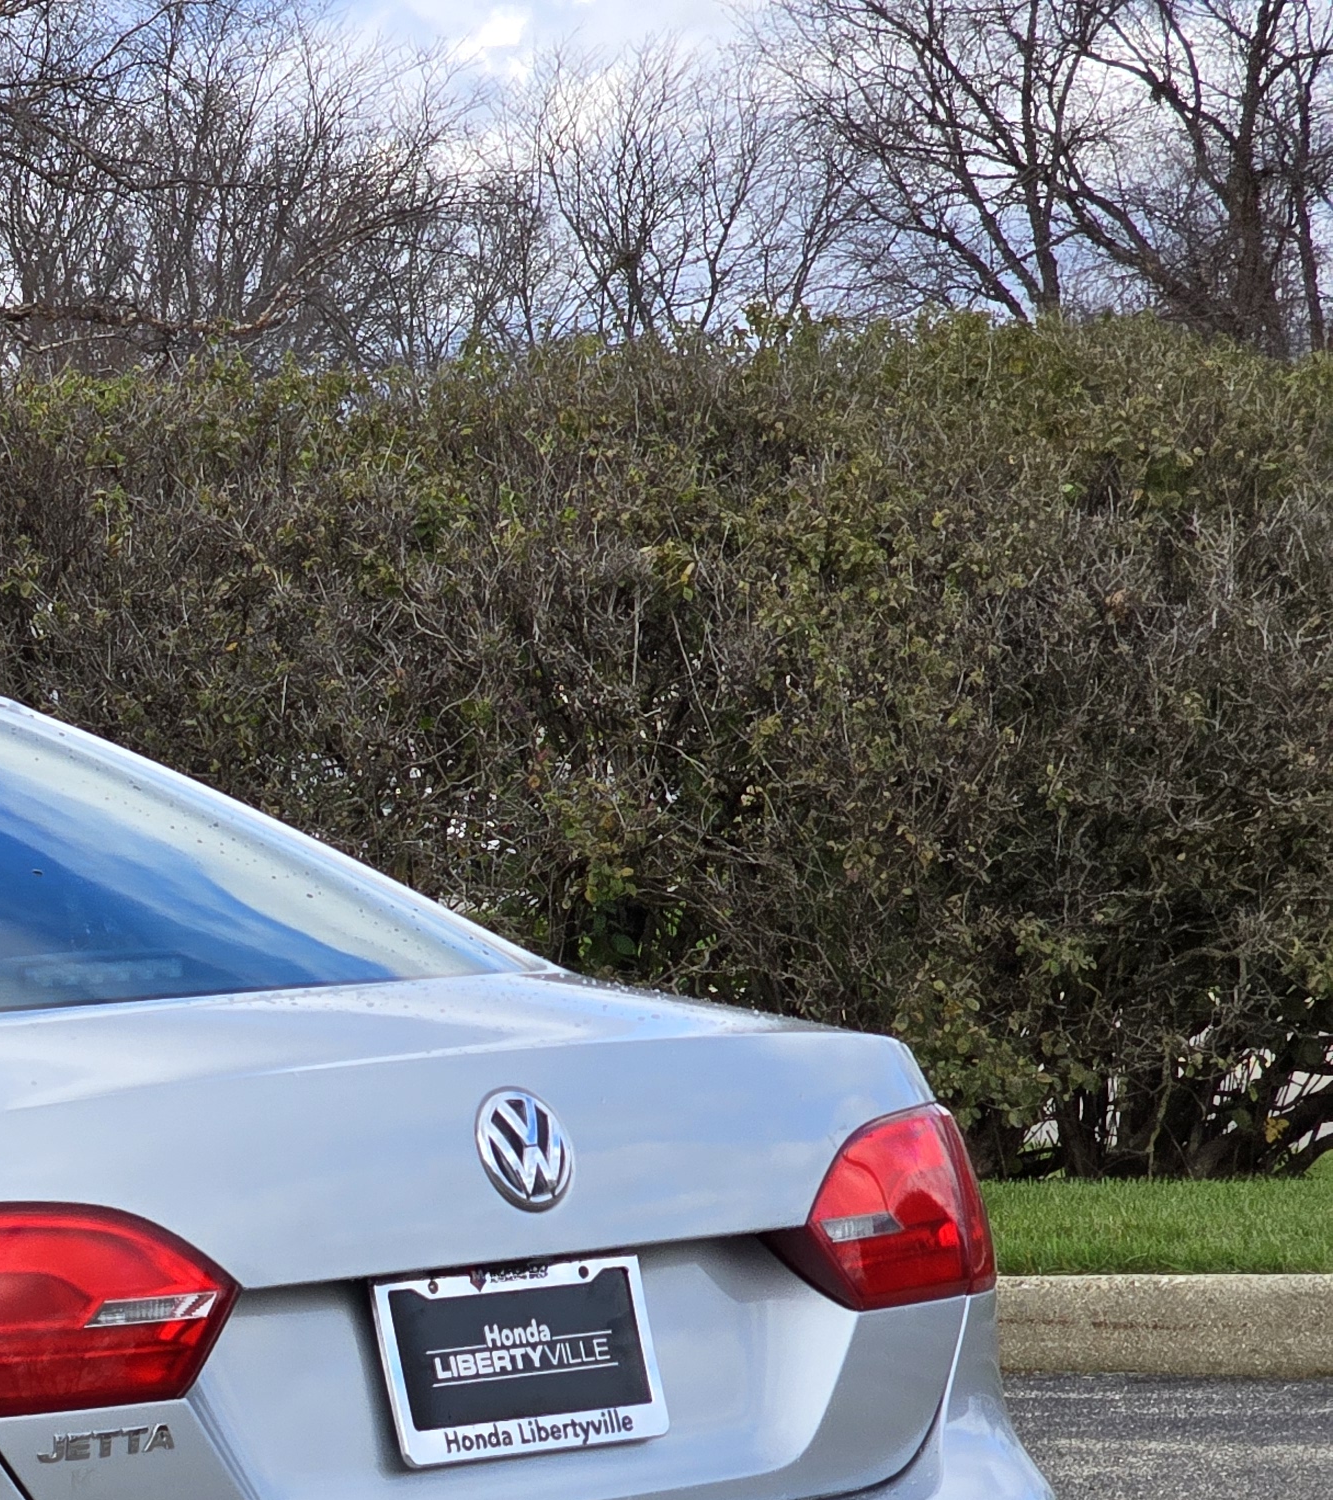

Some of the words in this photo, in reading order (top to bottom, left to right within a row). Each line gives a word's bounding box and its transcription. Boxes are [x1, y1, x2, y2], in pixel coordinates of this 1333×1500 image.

[484, 1319, 551, 1348] Honda
[433, 1338, 611, 1380] LIBERTYVILLE
[36, 1422, 175, 1464] JETTA
[444, 1422, 513, 1453] Honda
[520, 1408, 634, 1445] Libertyville
